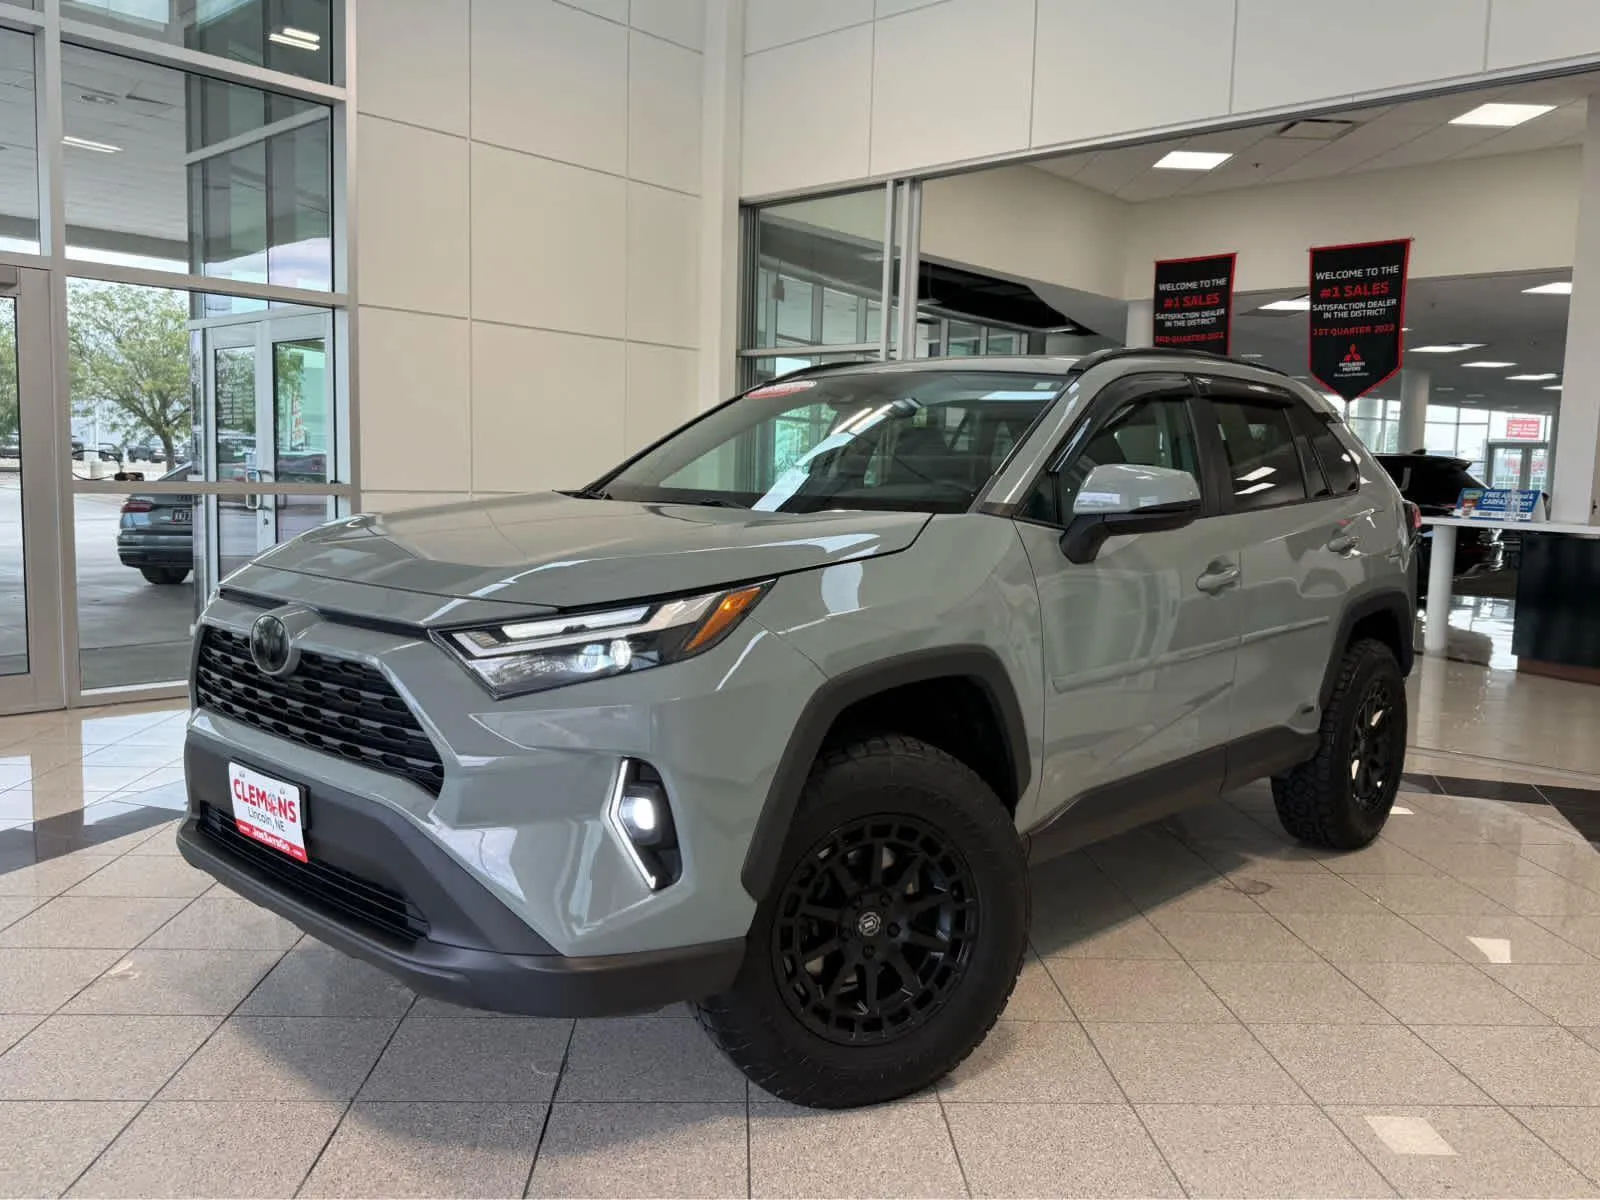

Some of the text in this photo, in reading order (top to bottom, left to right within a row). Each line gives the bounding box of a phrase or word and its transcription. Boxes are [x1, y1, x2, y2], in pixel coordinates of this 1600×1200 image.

[1315, 264, 1400, 280] WELCOME TO THE
[1158, 277, 1227, 291] WELCOME TO THE
[1320, 281, 1390, 298] #1 SALES
[1164, 293, 1220, 309] #1 SALES
[1312, 298, 1397, 311] SATISFACTION DEALER
[1155, 308, 1225, 320] SATISFACTION DEALER
[1350, 308, 1386, 317] DISTRICT!
[1174, 319, 1185, 327] THE
[1330, 325, 1372, 336] QUARTER
